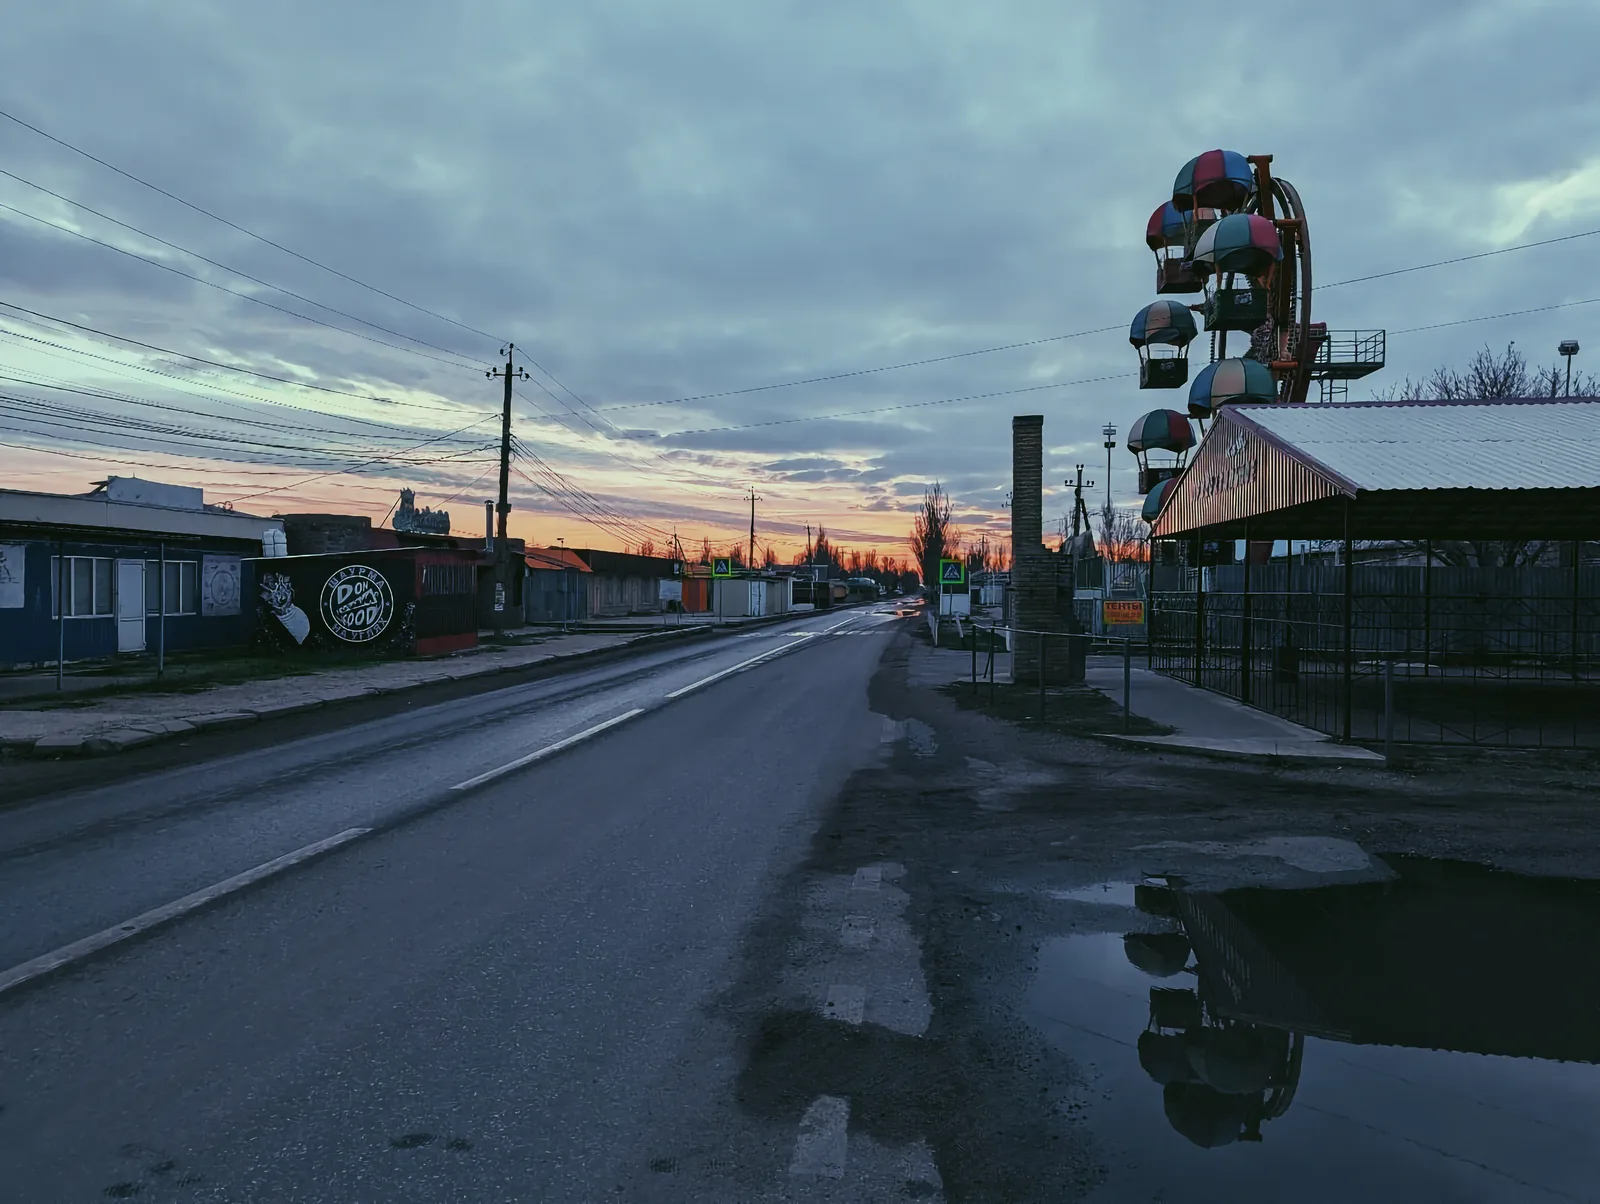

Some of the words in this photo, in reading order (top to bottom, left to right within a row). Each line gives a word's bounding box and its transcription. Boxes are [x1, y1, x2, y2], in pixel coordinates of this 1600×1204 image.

[328, 568, 384, 589] ШАУРМА
[332, 623, 347, 638] НА
[351, 617, 388, 640] УГЛЯХ
